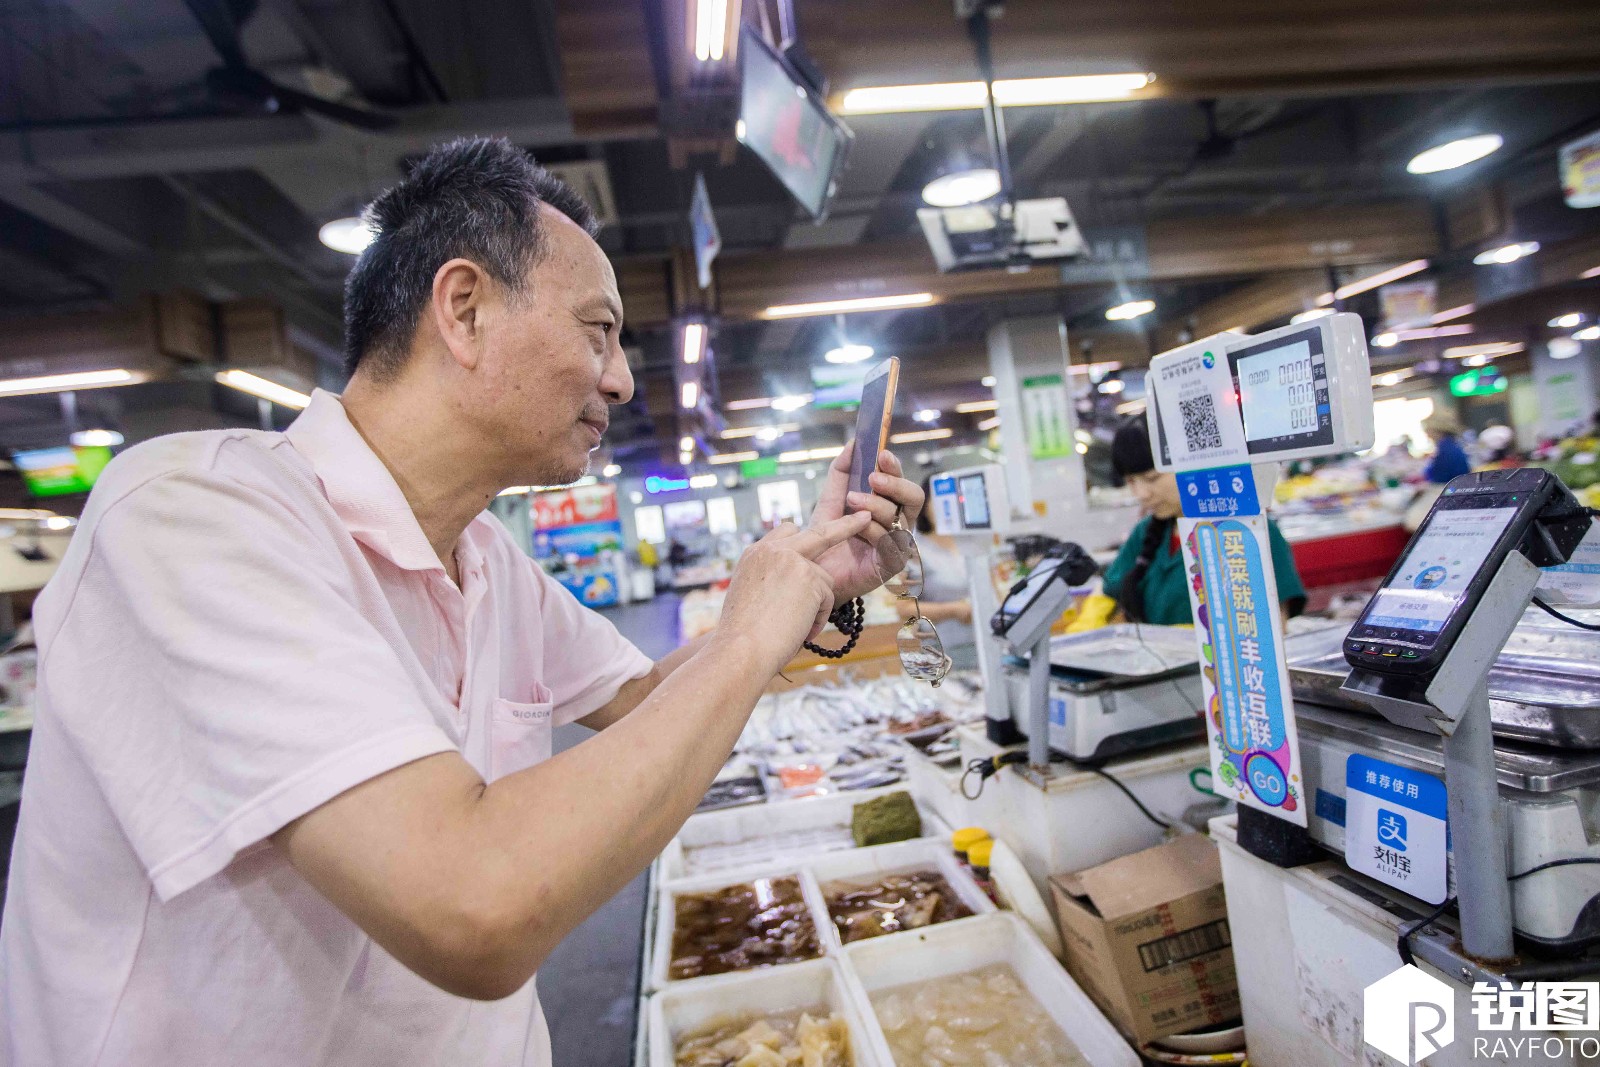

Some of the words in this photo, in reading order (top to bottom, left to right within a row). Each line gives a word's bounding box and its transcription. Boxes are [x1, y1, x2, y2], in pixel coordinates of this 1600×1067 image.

[1321, 415, 1330, 426] 元
[1198, 497, 1239, 513] 欢迎使用
[1222, 530, 1273, 748] 买菜就刷丰收互联
[1253, 769, 1281, 792] GO
[1366, 769, 1419, 799] 推荐使用
[1374, 846, 1411, 874] 支付宝
[1376, 863, 1408, 881] ALIPAY
